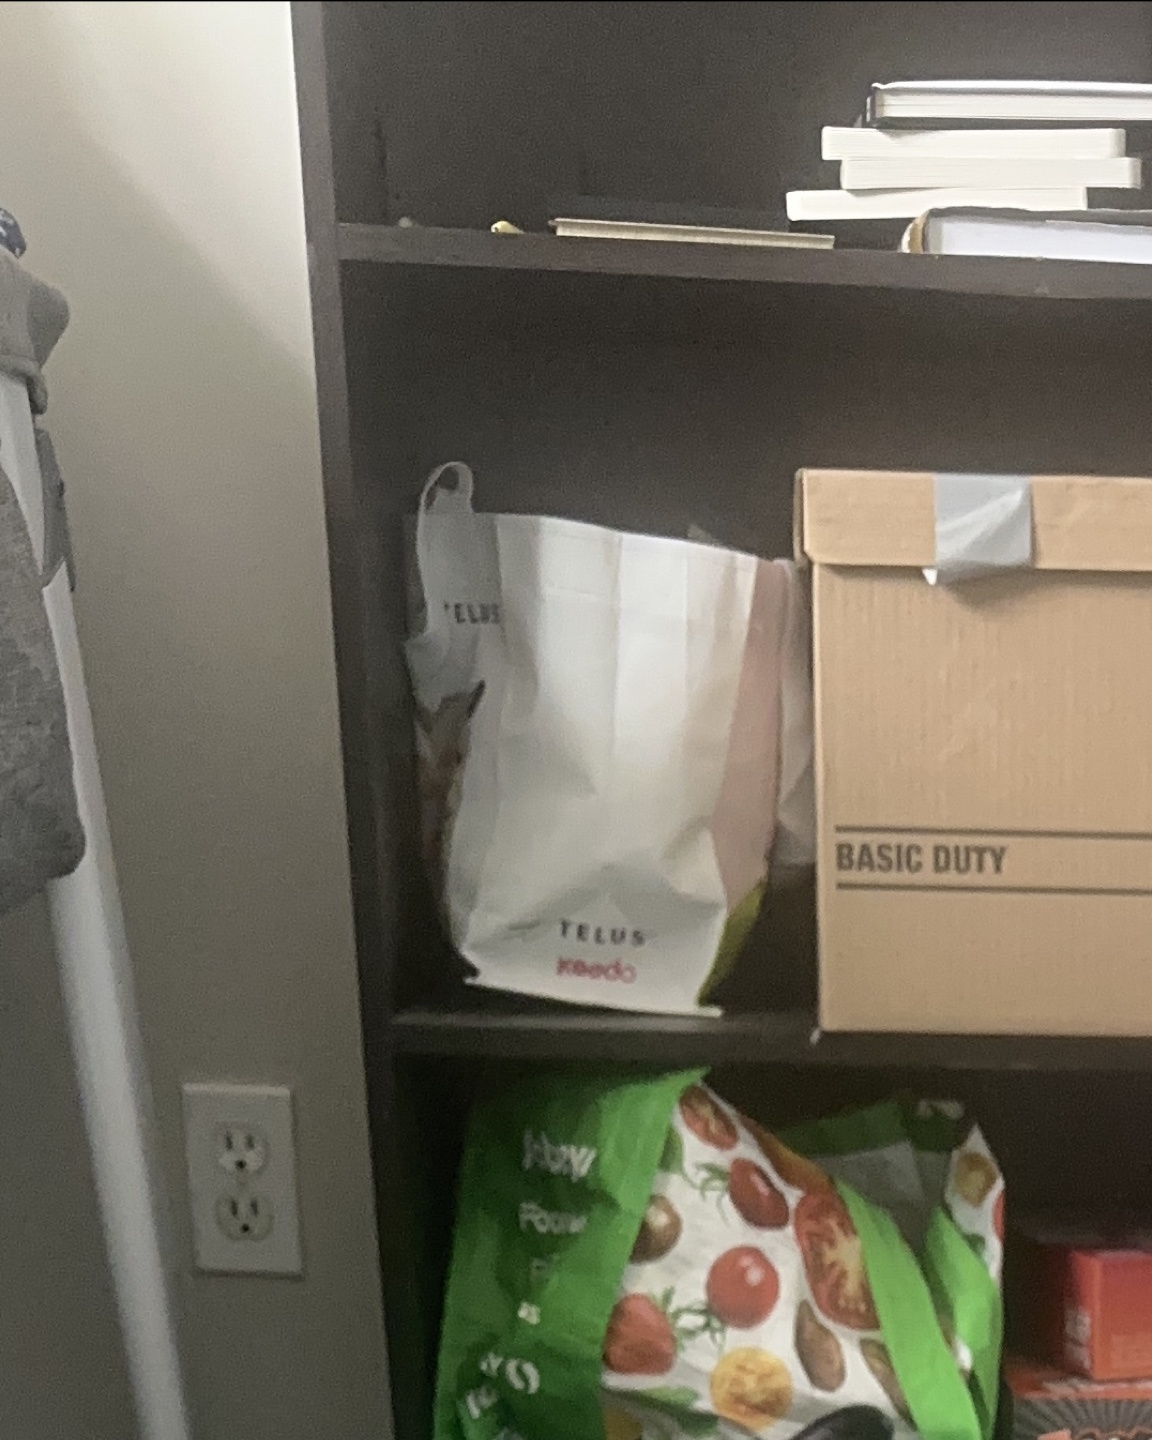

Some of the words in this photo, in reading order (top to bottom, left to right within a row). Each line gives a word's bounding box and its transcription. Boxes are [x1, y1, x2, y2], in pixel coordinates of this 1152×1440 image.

[443, 601, 501, 625] ELUS
[835, 842, 924, 873] BASIC
[931, 844, 1009, 875] DUTY
[560, 918, 646, 947] TELUS
